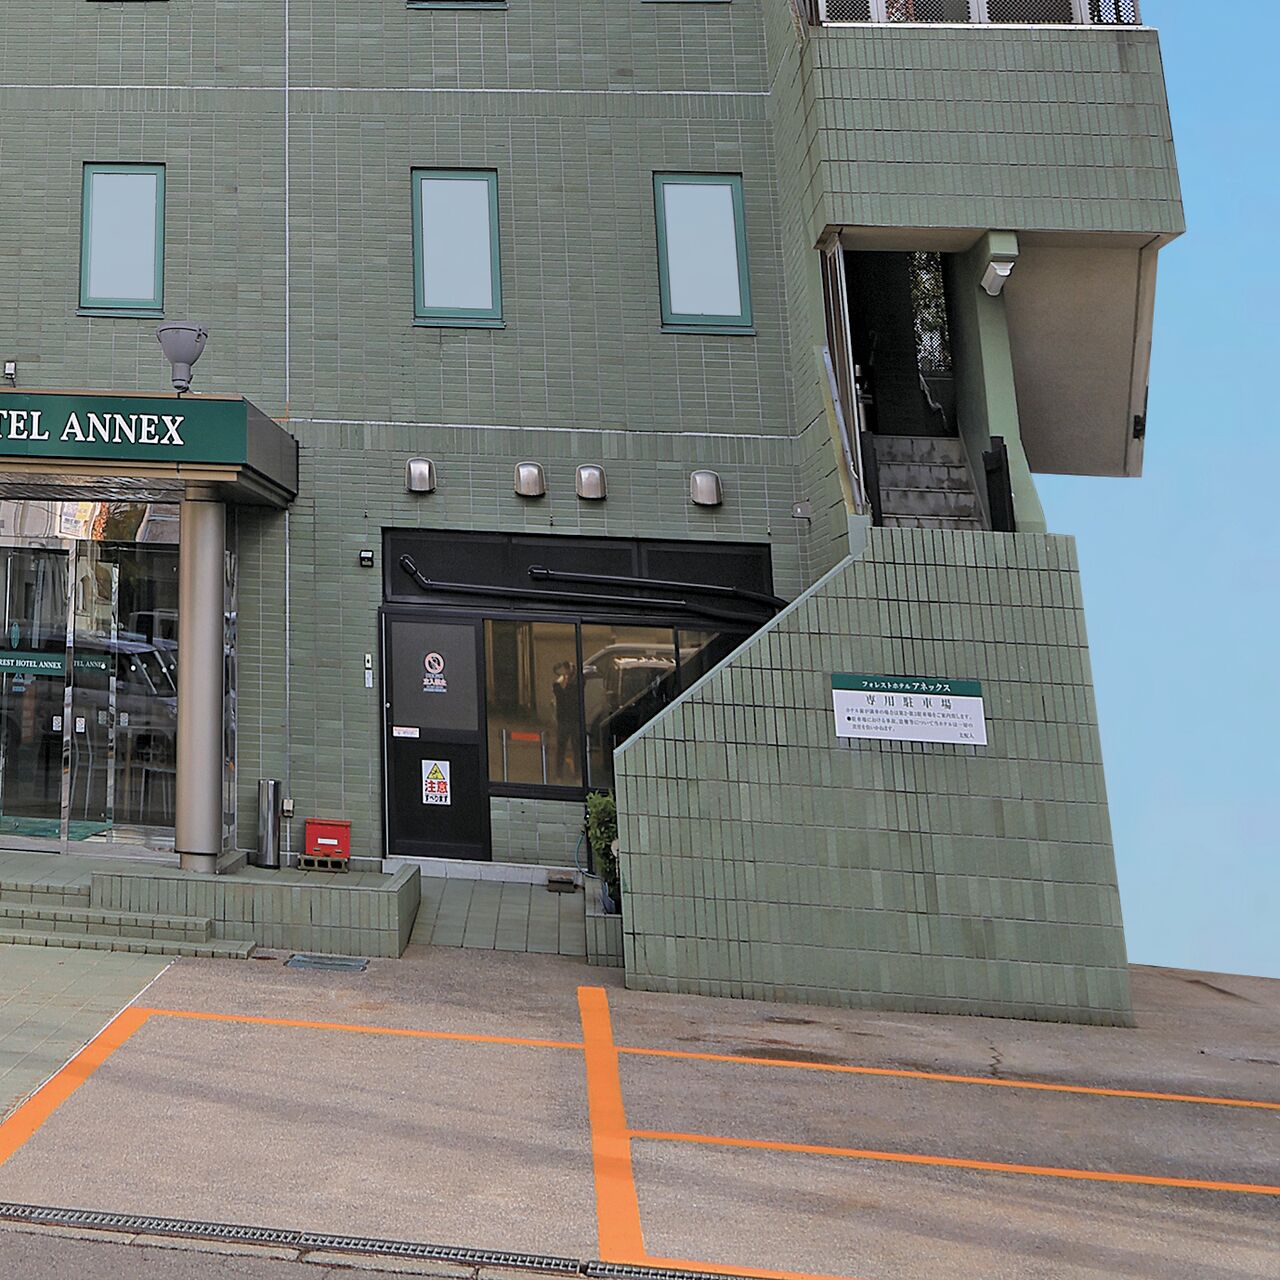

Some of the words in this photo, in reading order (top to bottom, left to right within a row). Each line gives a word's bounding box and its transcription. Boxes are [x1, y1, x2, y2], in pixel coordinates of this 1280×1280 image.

[60, 411, 185, 445] ANNEX
[16, 659, 37, 668] HOTEL
[38, 661, 62, 669] ANNEX
[425, 780, 448, 793] 注意
